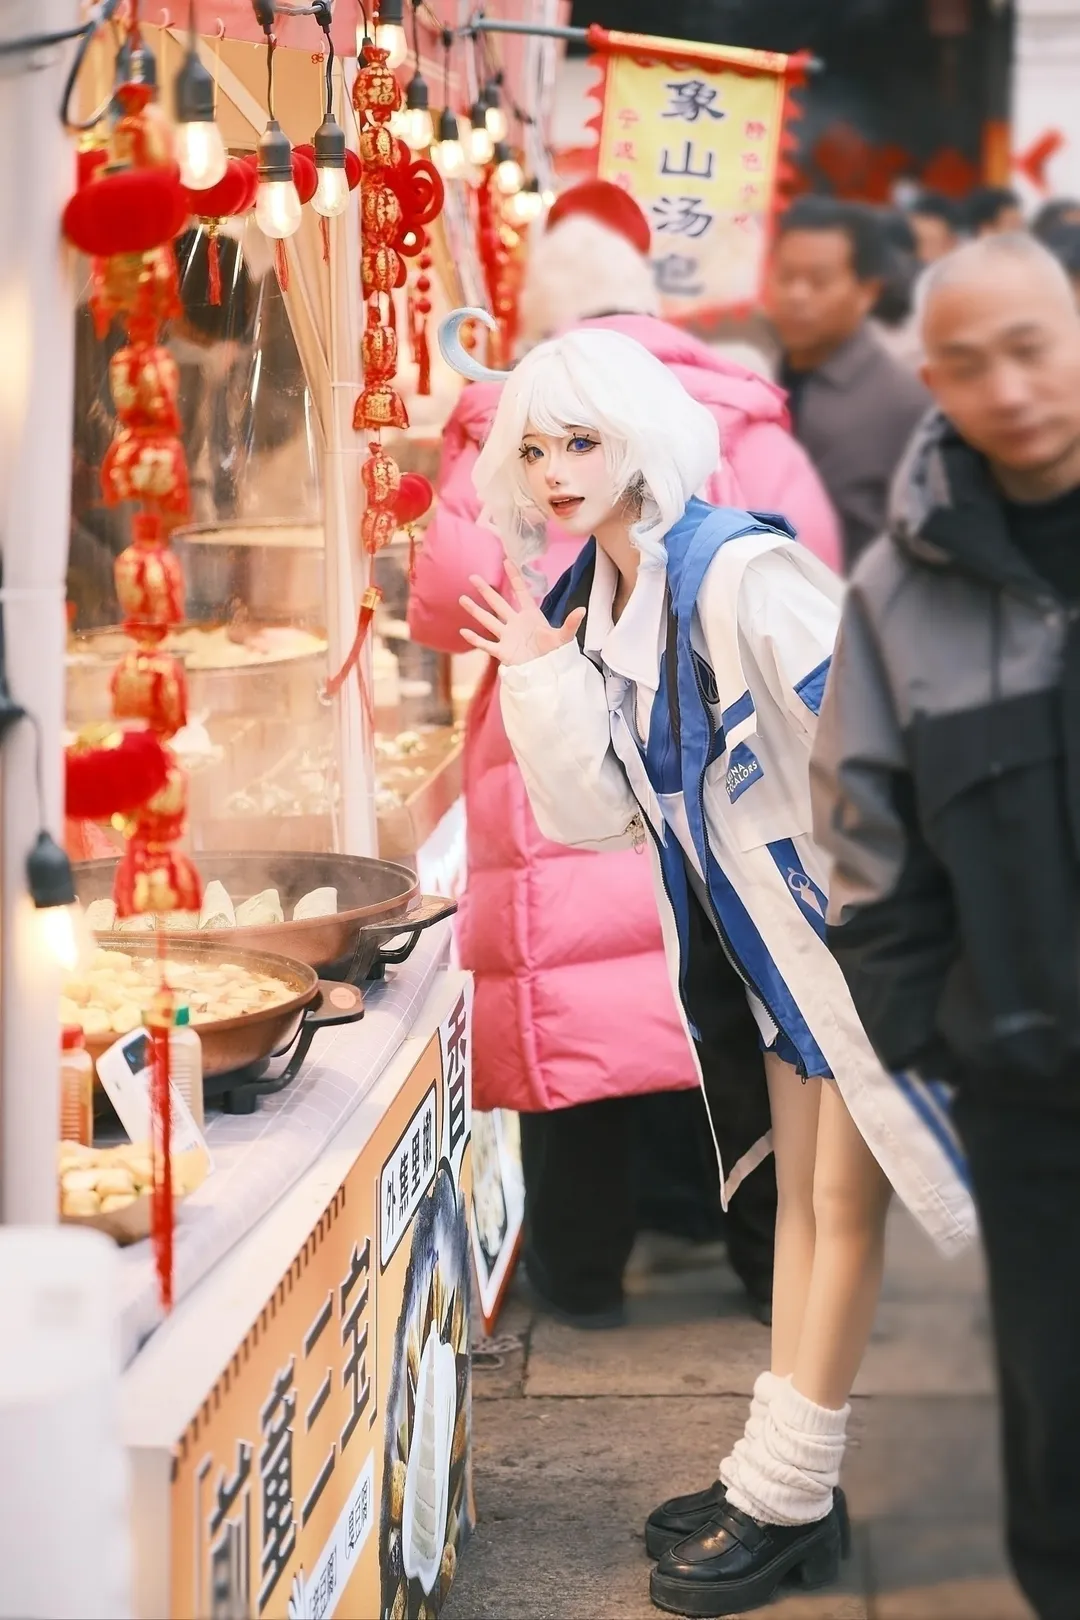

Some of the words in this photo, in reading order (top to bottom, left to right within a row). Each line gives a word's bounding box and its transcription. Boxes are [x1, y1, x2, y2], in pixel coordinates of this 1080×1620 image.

[652, 79, 725, 296] 象山汤包
[386, 1107, 432, 1243] 外焦里嫩
